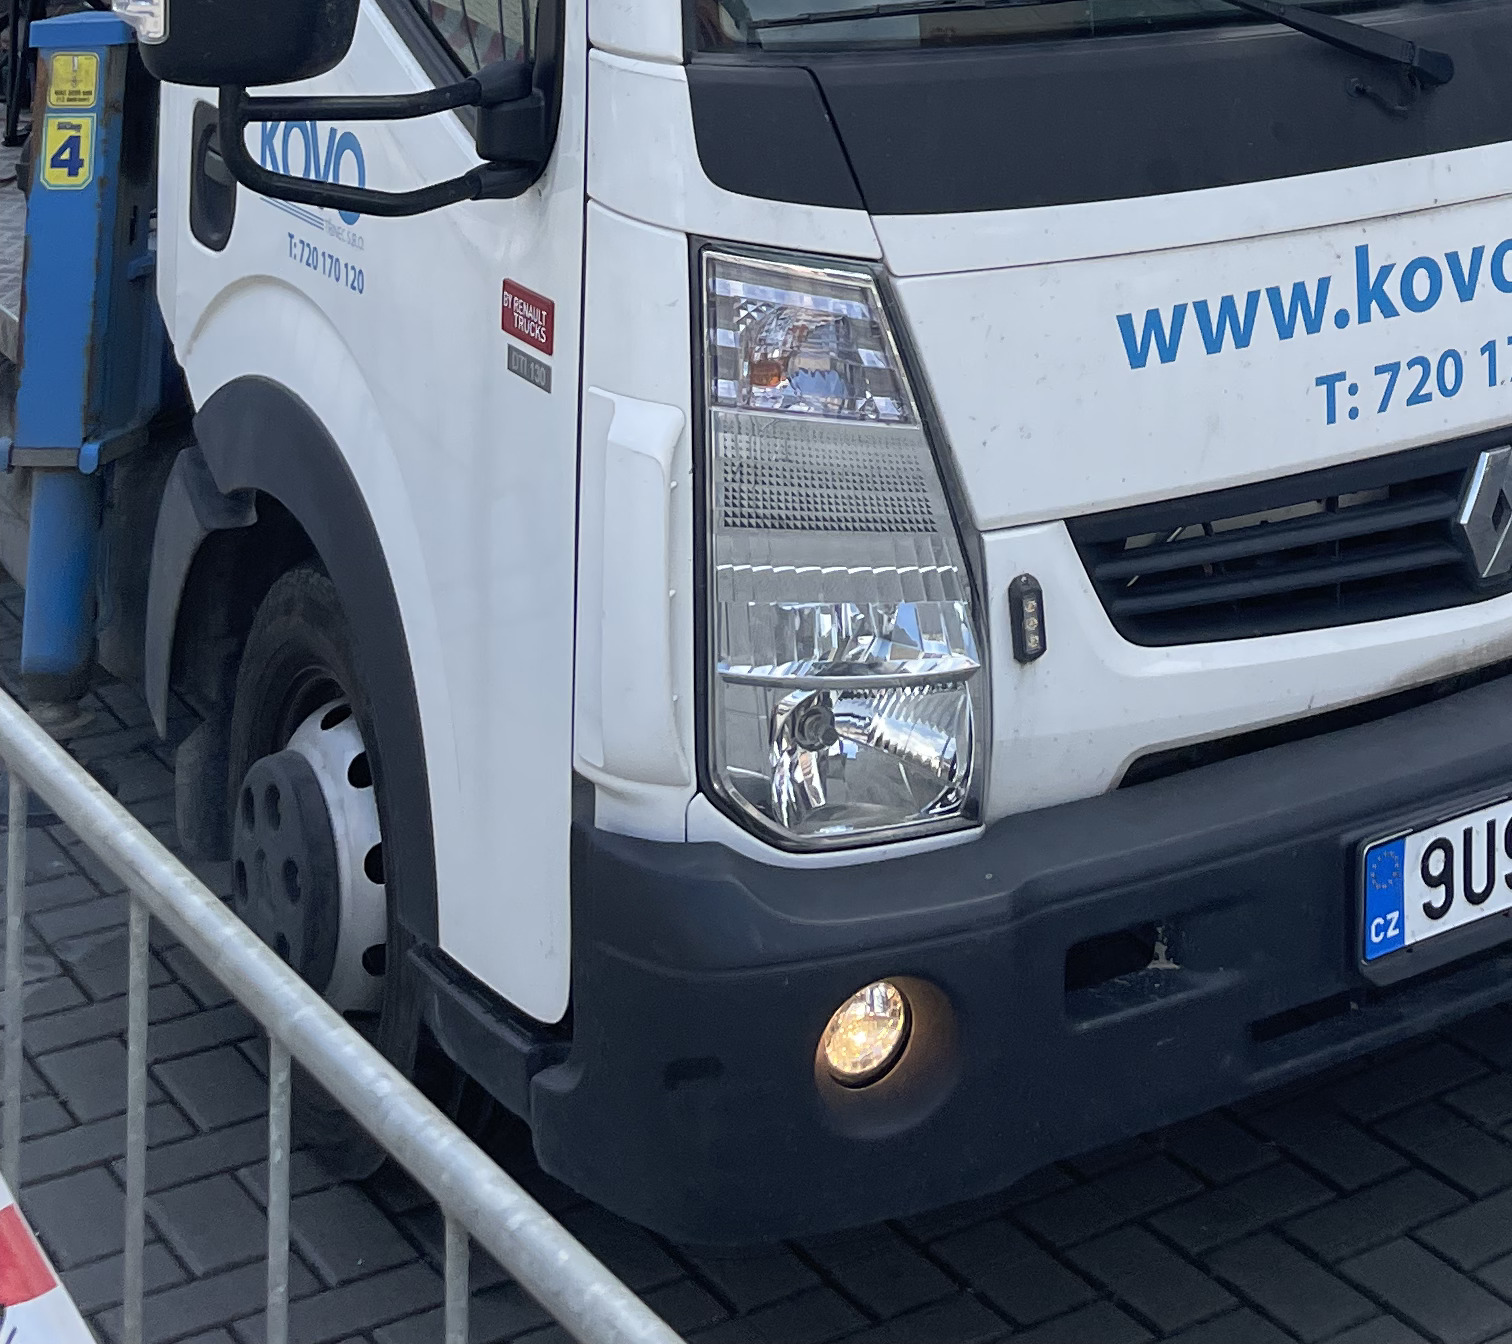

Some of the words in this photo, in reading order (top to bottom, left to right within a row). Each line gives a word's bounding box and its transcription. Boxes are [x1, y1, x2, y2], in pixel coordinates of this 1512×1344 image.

[50, 135, 84, 178] 4
[287, 231, 297, 261] T:
[298, 238, 319, 272] 720
[321, 250, 341, 283] 170
[344, 262, 365, 295] 120
[503, 290, 513, 310] BY
[513, 296, 547, 327] RENAULT
[513, 312, 547, 343] TRUCKS
[511, 350, 527, 375] DTI
[530, 362, 546, 386] 130
[1315, 371, 1360, 426] T:
[1375, 348, 1464, 414] 720
[1370, 911, 1400, 944] CZ
